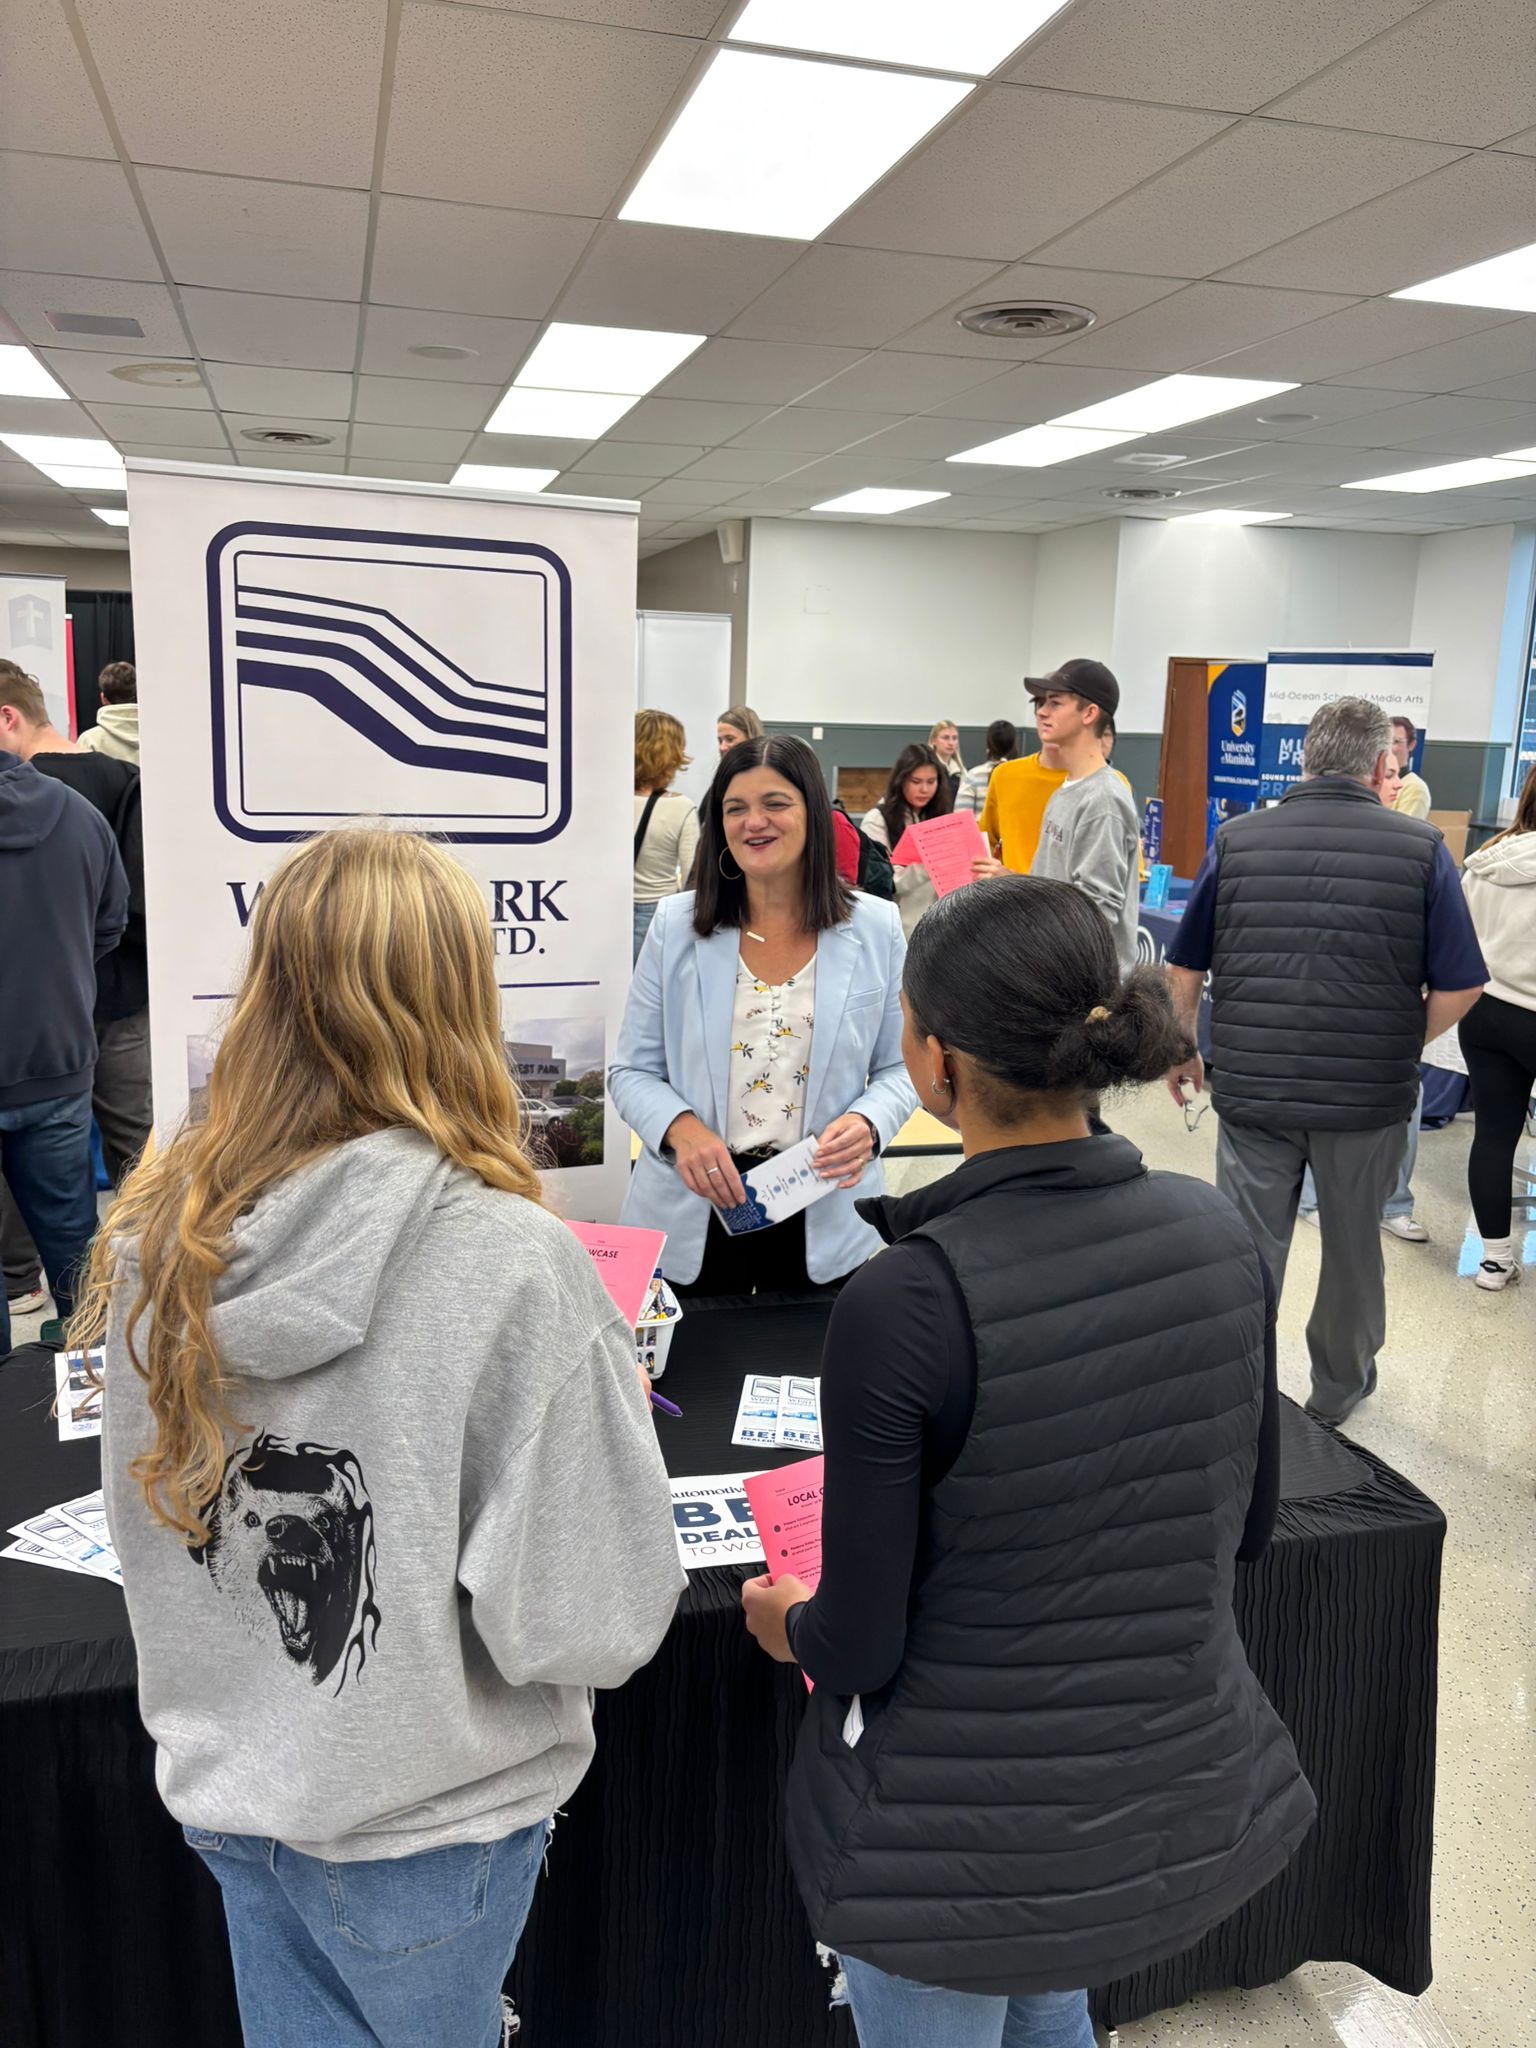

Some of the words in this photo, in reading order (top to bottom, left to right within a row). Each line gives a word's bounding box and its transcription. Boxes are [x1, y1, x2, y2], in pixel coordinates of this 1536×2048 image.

[1269, 691, 1321, 701] Mid-Ocean
[1370, 694, 1402, 704] Media
[1405, 695, 1424, 705] Arts
[1221, 740, 1255, 757] University
[1261, 773, 1285, 781] SOUND
[1286, 774, 1302, 783] ENG
[516, 1063, 535, 1075] EST
[537, 1063, 560, 1075] PARK
[587, 1247, 619, 1259] WCASE
[787, 1490, 818, 1506] LOCAL
[680, 1527, 762, 1544] DEAL
[686, 1545, 717, 1556] TO
[722, 1540, 762, 1553] WO
